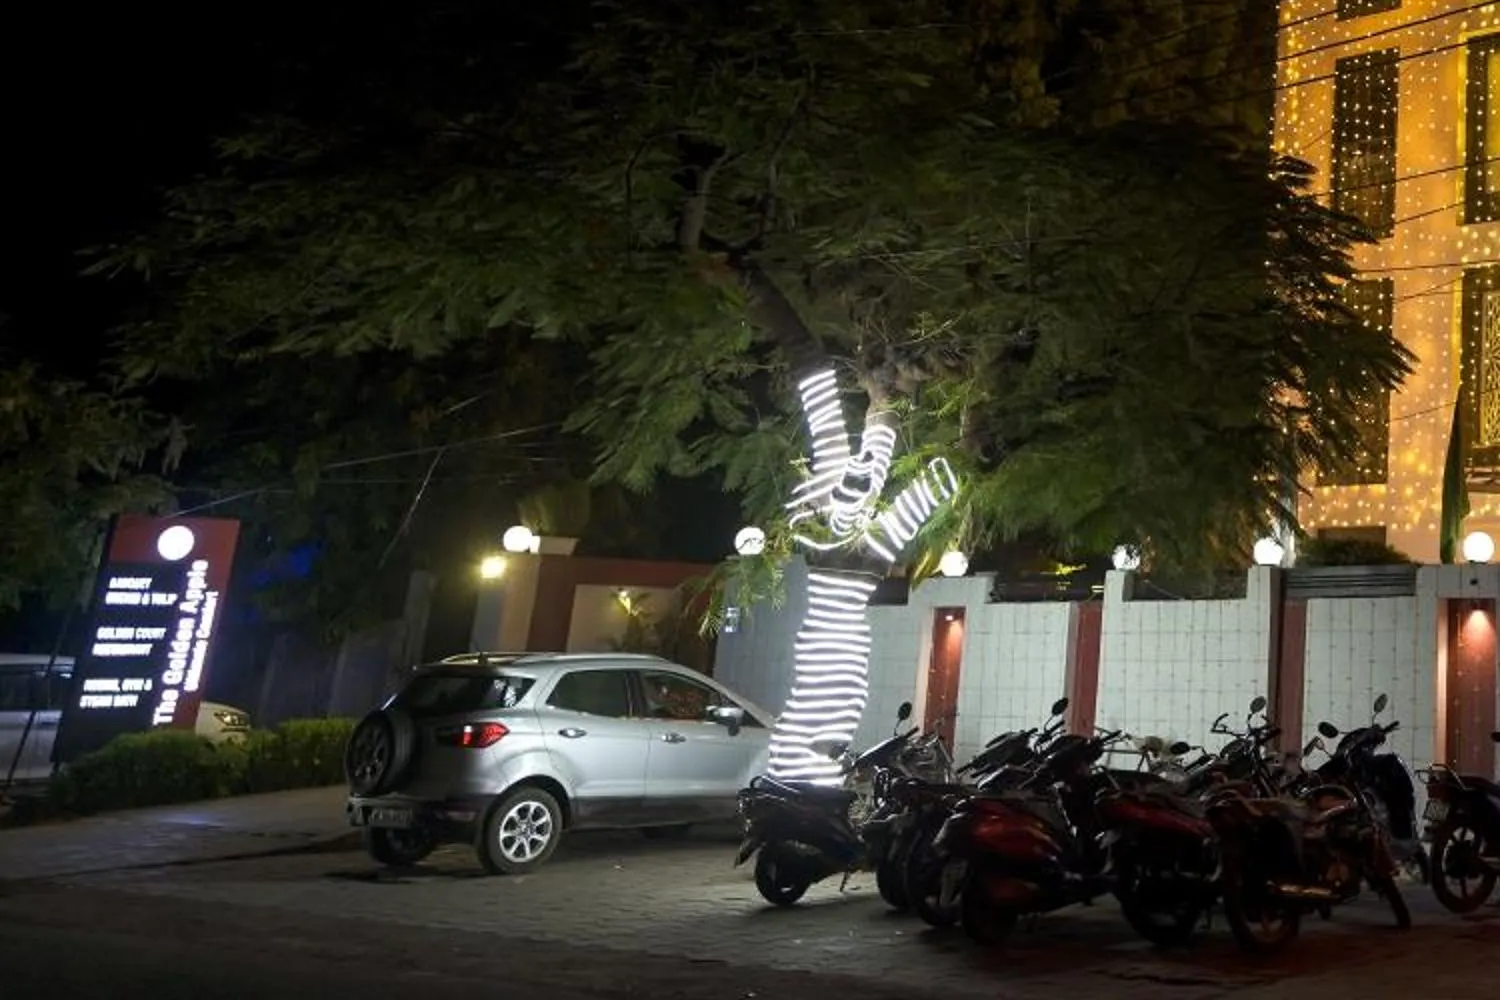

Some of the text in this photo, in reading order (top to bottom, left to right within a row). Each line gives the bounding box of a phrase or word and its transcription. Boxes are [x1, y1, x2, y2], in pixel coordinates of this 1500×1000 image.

[153, 559, 209, 725] The Golden Apple
